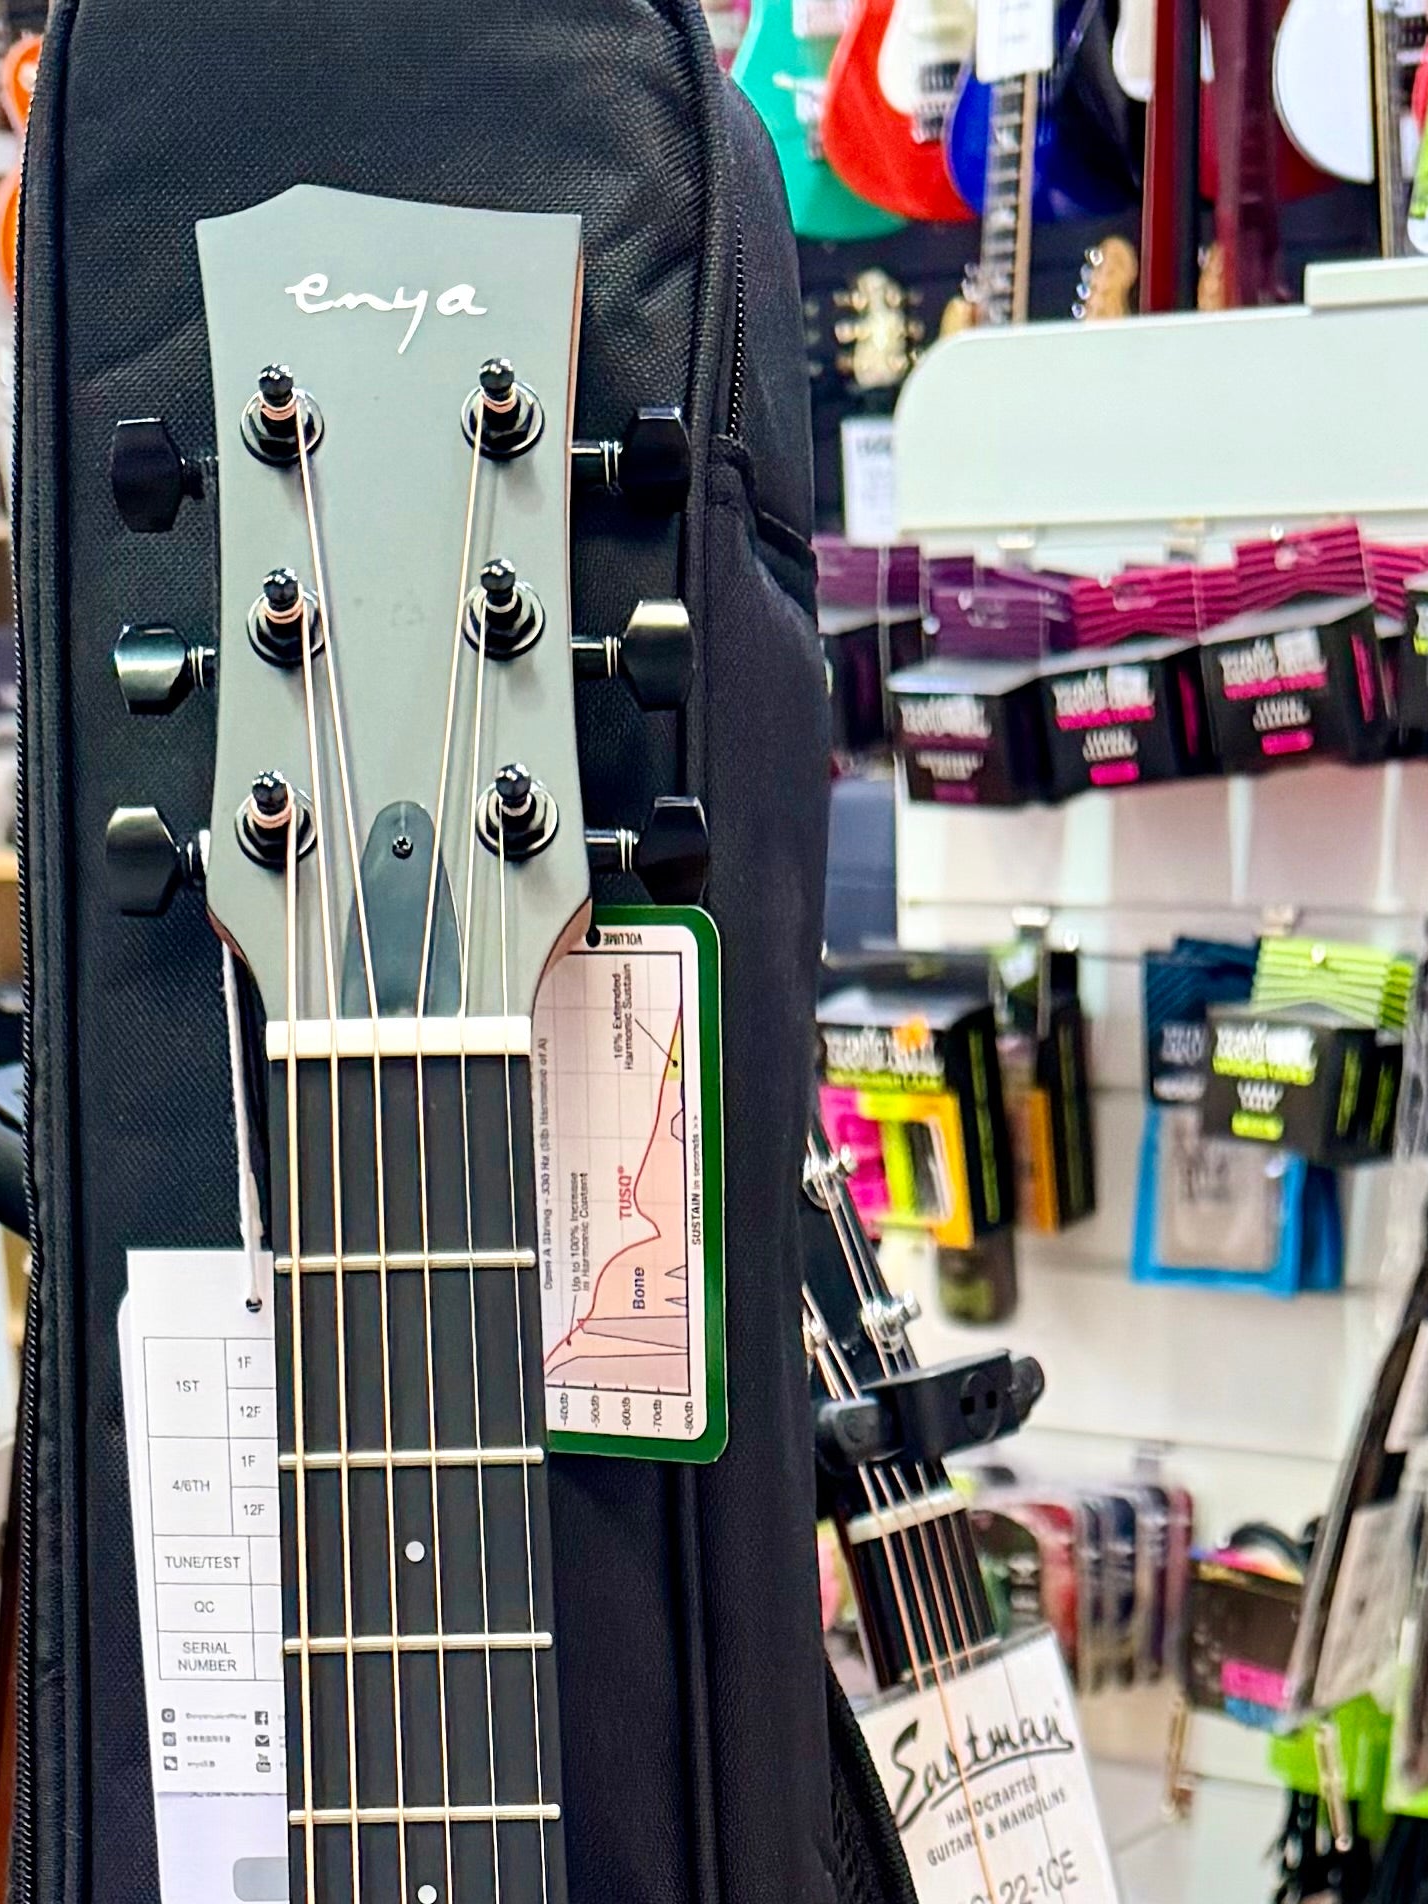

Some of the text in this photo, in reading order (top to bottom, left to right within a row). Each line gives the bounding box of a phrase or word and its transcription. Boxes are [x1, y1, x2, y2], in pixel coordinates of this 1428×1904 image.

[284, 272, 488, 355] enya
[603, 932, 643, 946] VOLUME
[612, 973, 622, 1030] Extended
[622, 963, 634, 1070] Harmonic Sustain
[691, 1192, 702, 1246] SUSTAIN
[570, 1172, 582, 1292] Up to 100% Increase
[632, 1266, 645, 1310] Bone
[237, 1356, 252, 1369] 1F
[176, 1380, 200, 1393] 1ST
[239, 1405, 261, 1418] 12F
[241, 1455, 256, 1468] 1F
[172, 1480, 210, 1493] 4/6TH
[243, 1504, 265, 1516] 12F
[164, 1555, 242, 1569] TUNE/TEST
[194, 1600, 215, 1613] QC
[182, 1641, 232, 1655] SERIAL
[178, 1659, 238, 1673] NUMBER
[890, 1713, 1076, 1833] Eastman
[985, 1824, 995, 1840] &
[1000, 1787, 1067, 1833] MANDOLINS
